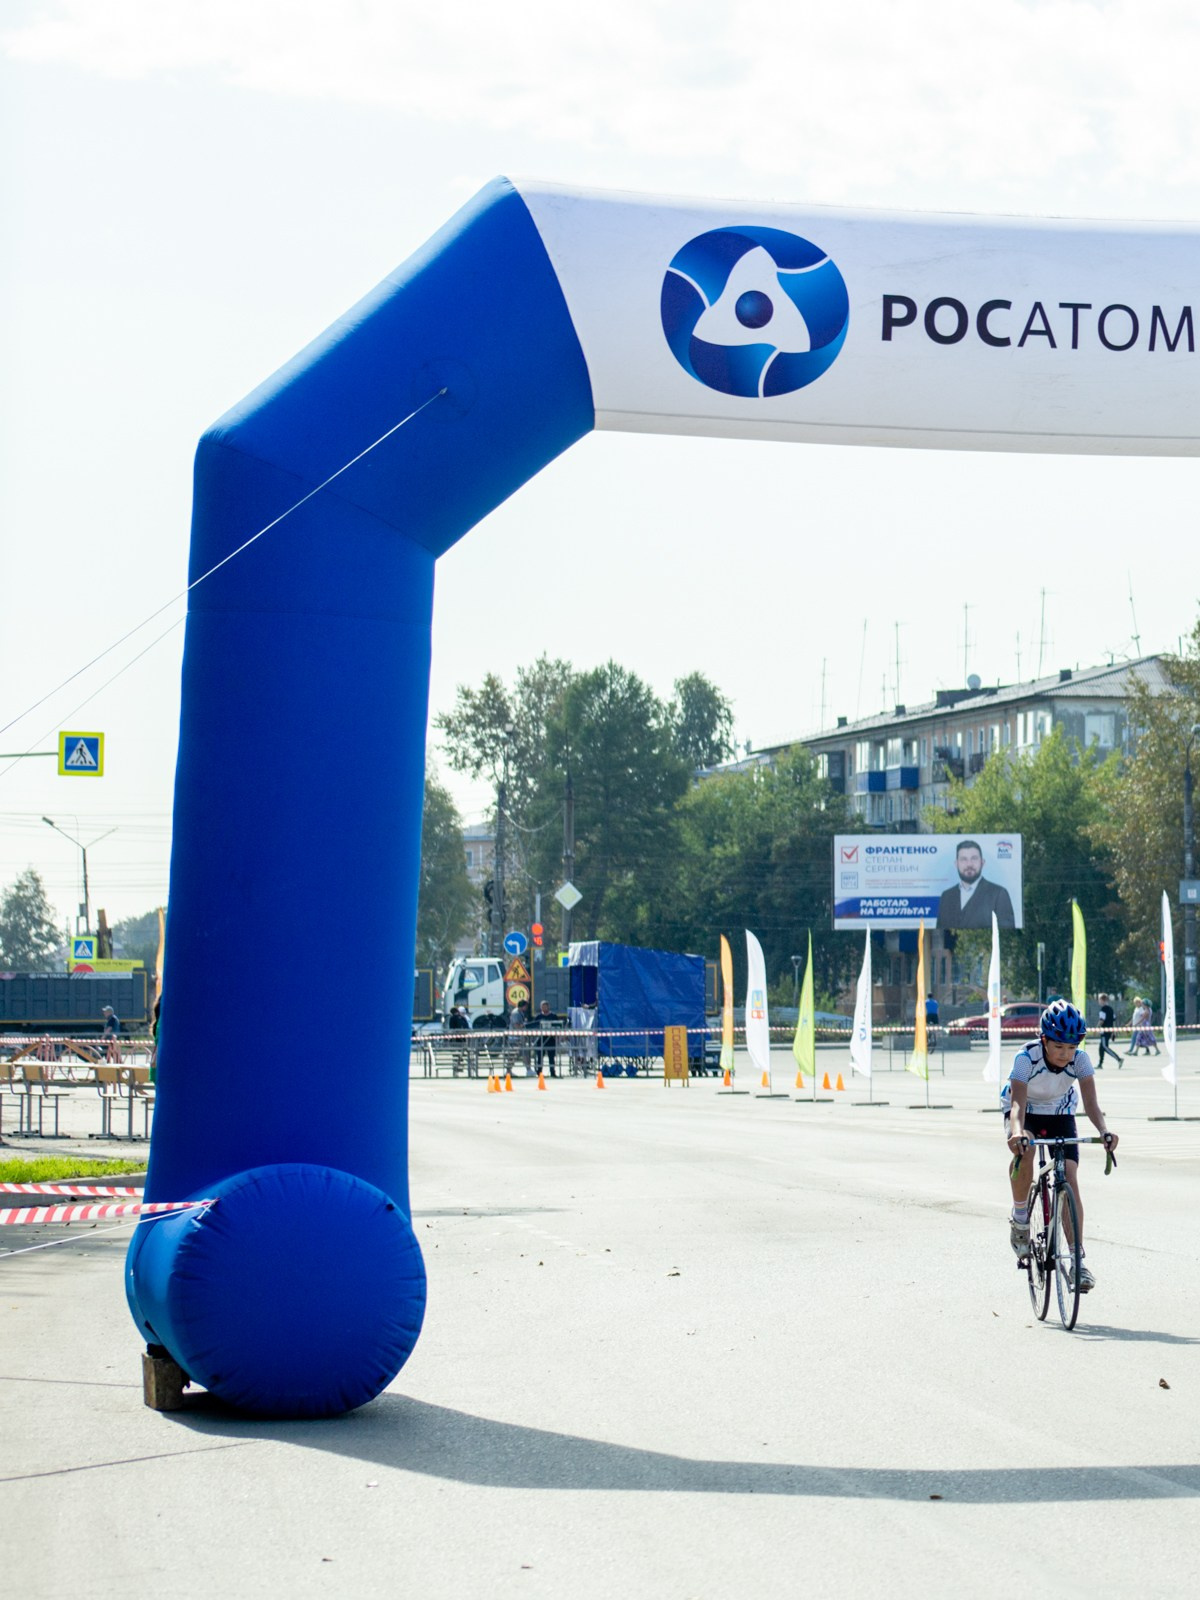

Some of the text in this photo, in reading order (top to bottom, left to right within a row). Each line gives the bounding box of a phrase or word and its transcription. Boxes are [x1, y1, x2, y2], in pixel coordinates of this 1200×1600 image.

[882, 294, 1195, 352] РОСАТОМ
[865, 846, 938, 854] ФРАНТЕНКО
[865, 856, 902, 864] СТЕПАН
[865, 865, 919, 873] СЕРГЕЕВИЧ
[860, 899, 909, 908] РАБОТАЮ
[860, 907, 931, 916] НА РЕЗУЛЬТАТ
[510, 990, 525, 1000] 40
